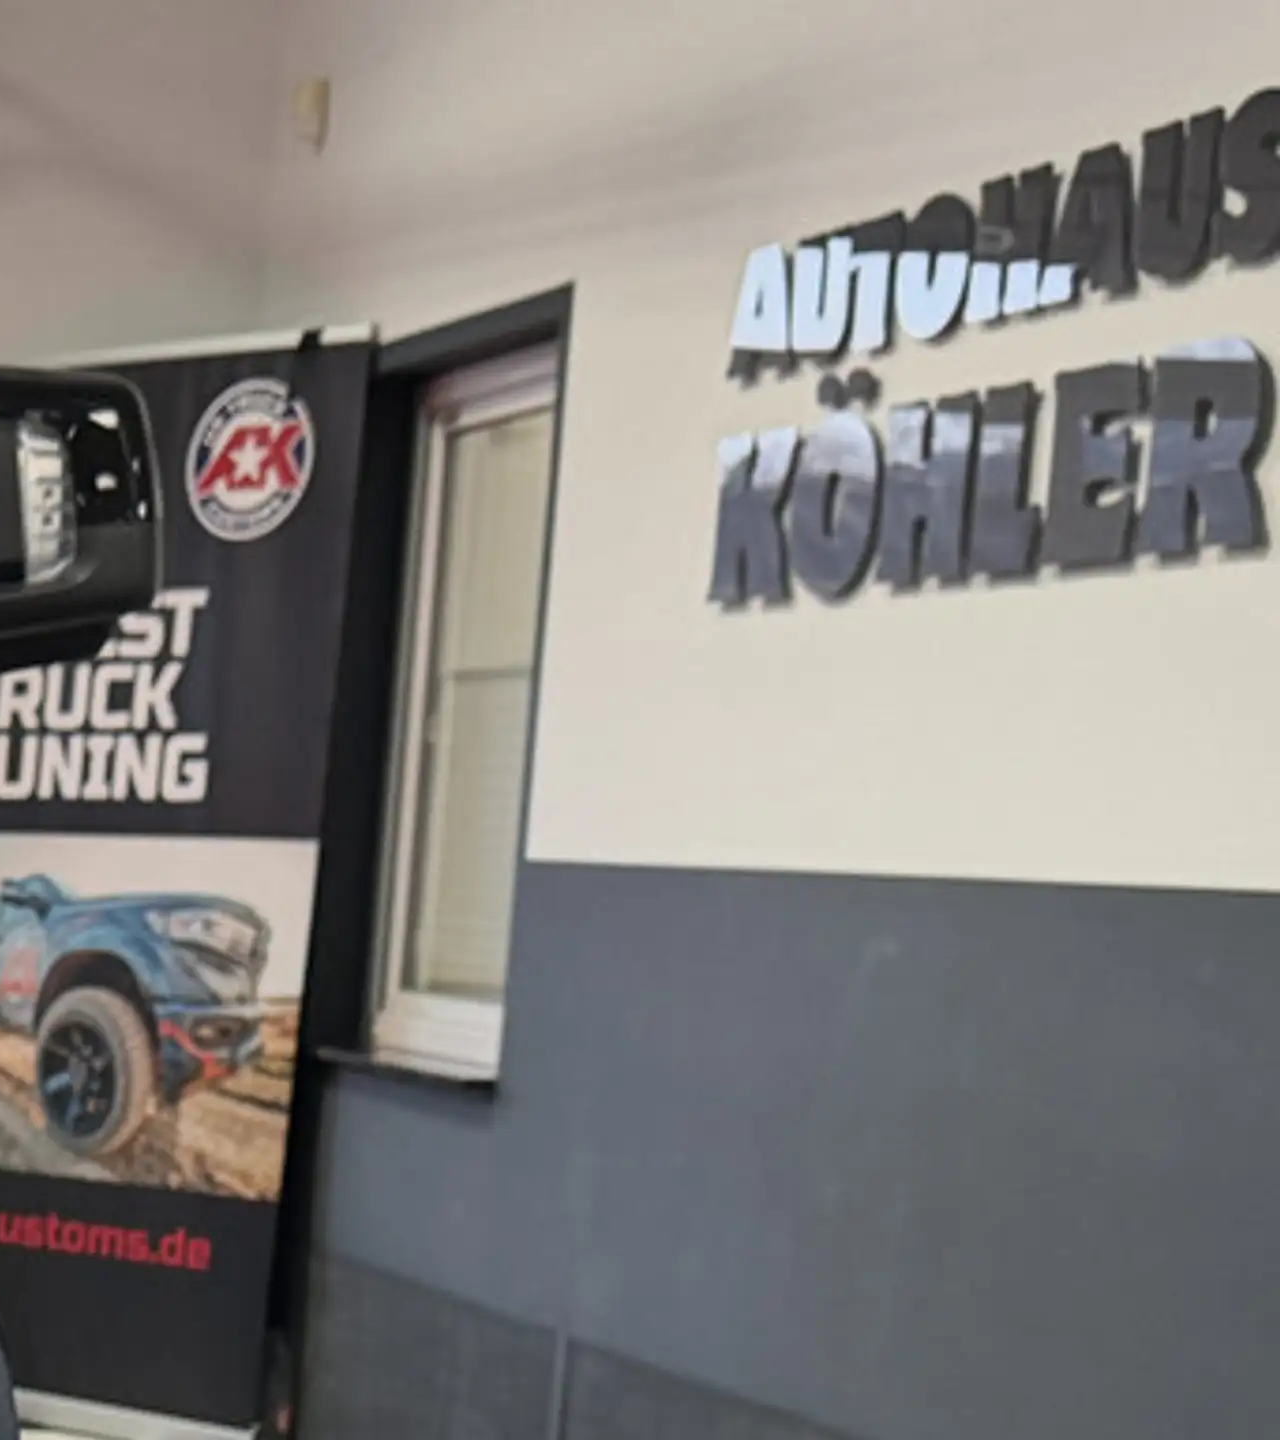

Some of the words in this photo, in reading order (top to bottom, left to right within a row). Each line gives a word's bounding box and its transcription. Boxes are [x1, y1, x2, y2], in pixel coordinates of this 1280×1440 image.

[727, 86, 1280, 388] AUTOHAUS
[706, 336, 1275, 612] KÖHLER
[96, 586, 211, 660] ST
